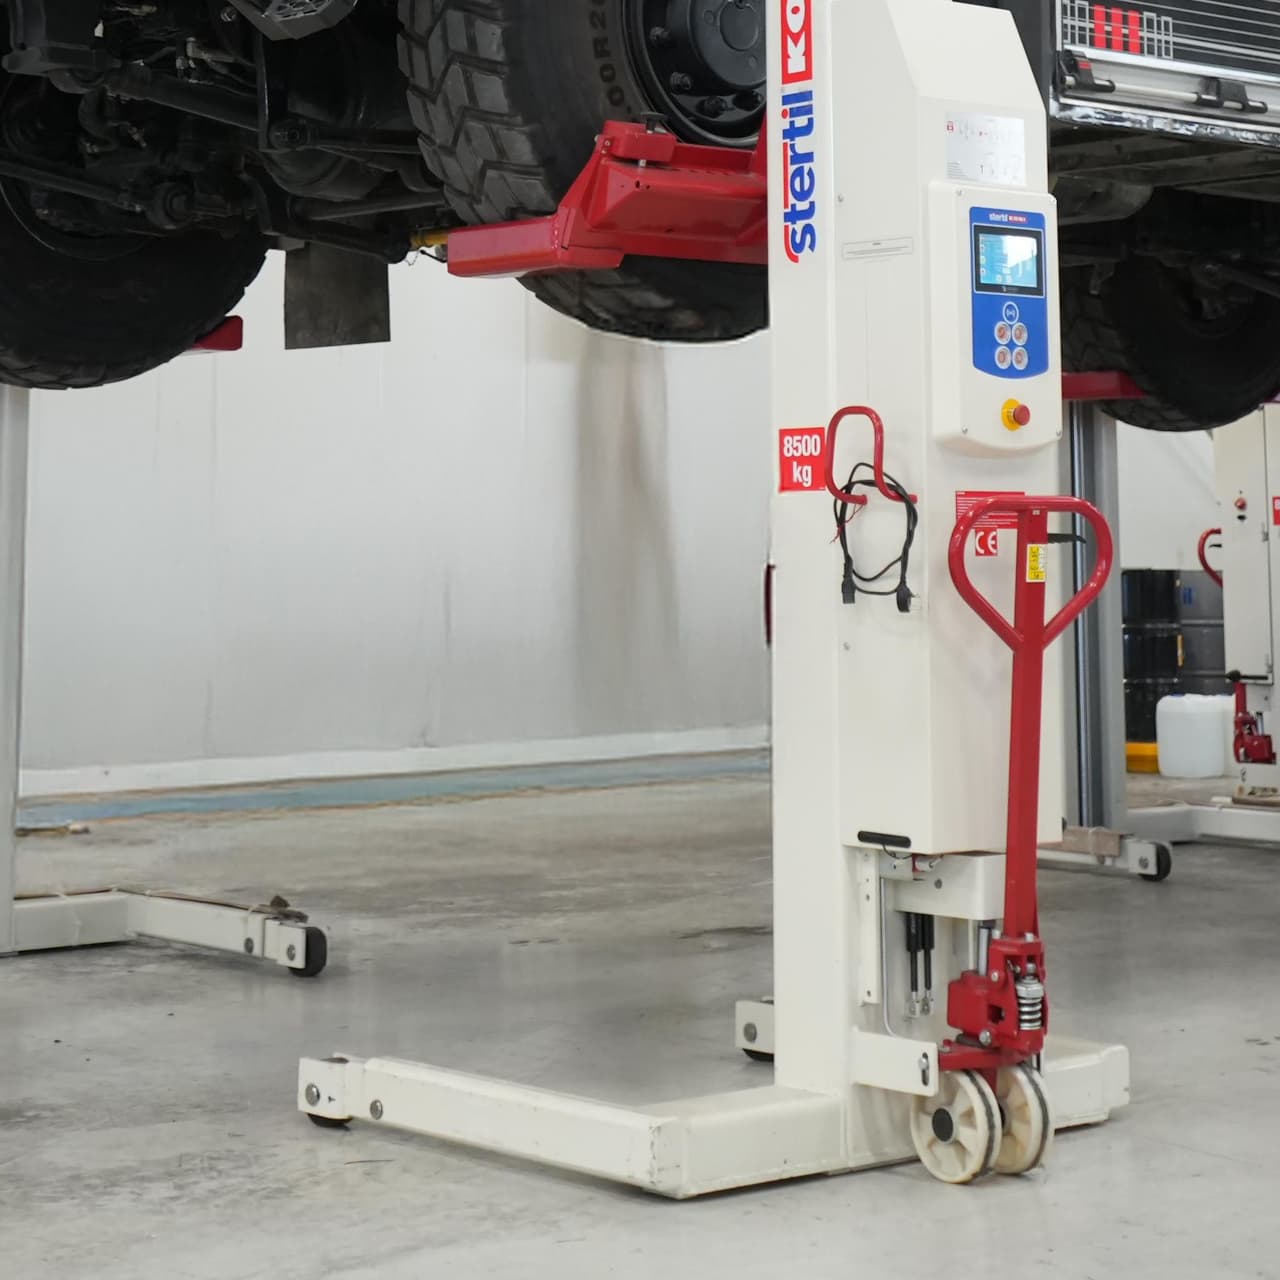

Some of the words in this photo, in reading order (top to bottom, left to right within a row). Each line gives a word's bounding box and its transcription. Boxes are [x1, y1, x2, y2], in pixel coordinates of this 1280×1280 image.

[781, 90, 818, 264] stertil
[783, 434, 821, 457] 8500
[792, 461, 812, 488] kg
